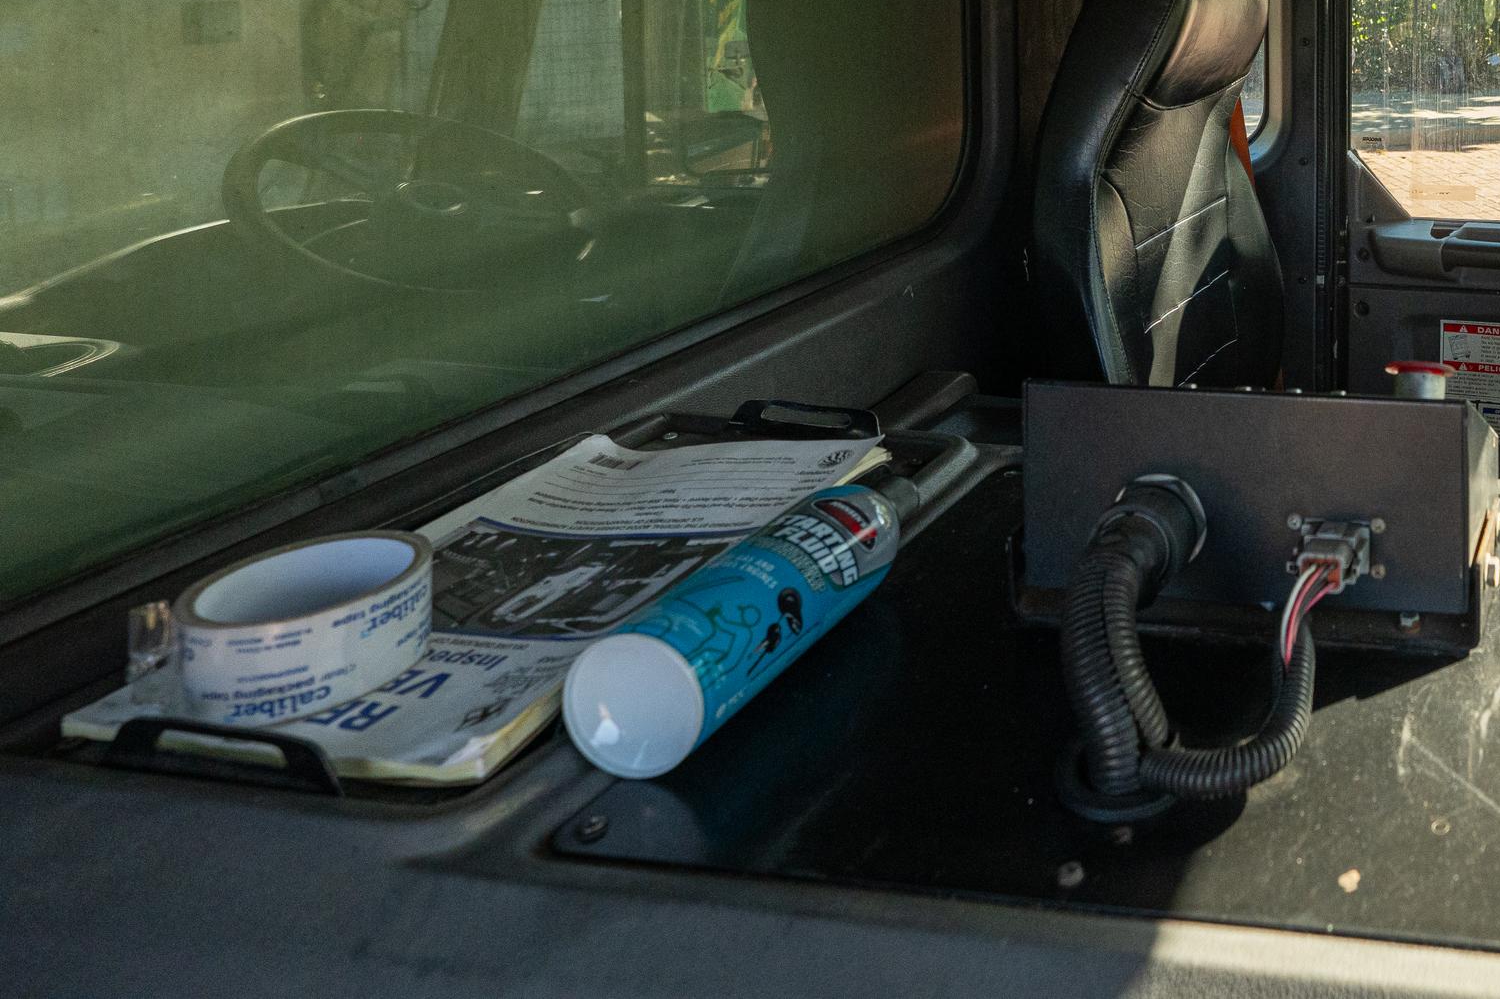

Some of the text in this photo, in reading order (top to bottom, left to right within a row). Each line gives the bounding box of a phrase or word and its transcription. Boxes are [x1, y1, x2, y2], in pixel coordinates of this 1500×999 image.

[773, 526, 839, 574] FLUID
[232, 685, 331, 719] caliber
[233, 676, 315, 701] packaging
